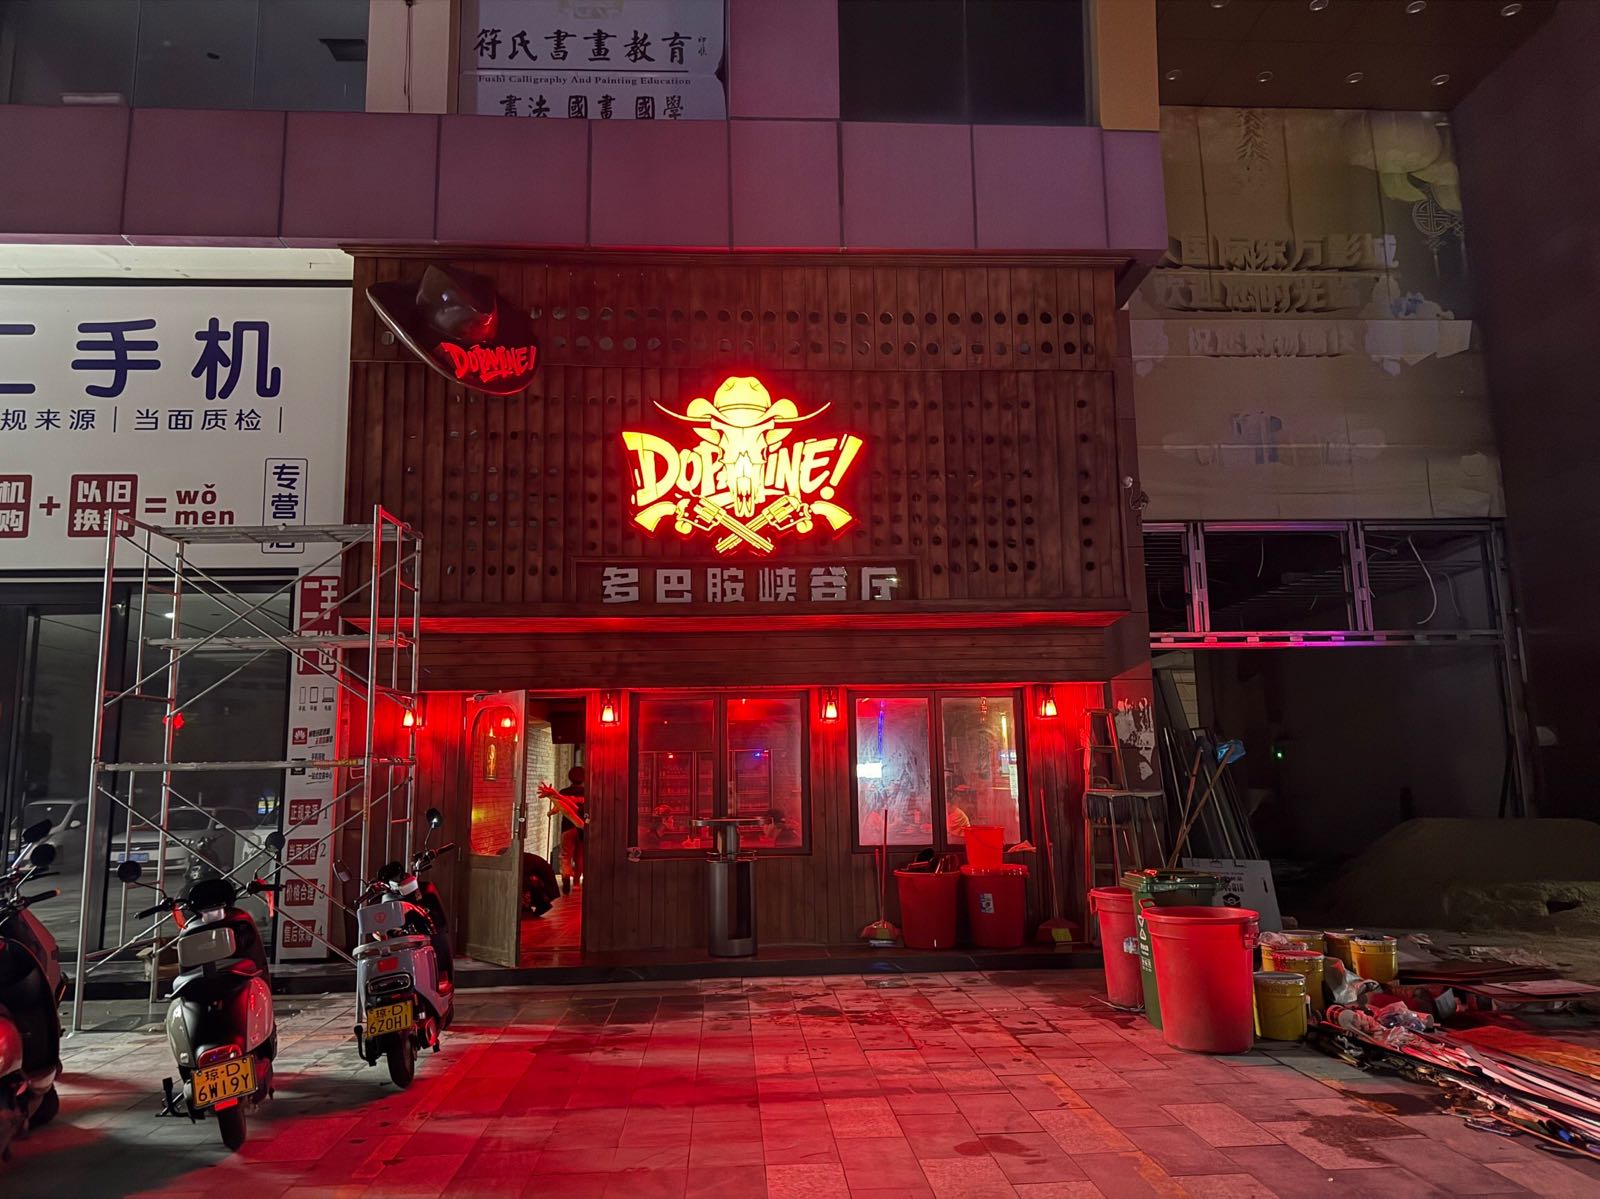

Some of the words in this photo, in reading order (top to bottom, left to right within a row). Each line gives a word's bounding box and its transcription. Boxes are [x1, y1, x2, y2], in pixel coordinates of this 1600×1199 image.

[508, 75, 568, 85] Calligraphy
[571, 76, 592, 84] And
[594, 76, 638, 86] Painting
[640, 77, 691, 85] Education
[0, 408, 97, 431] 规来源
[134, 408, 262, 431] 当面质检
[622, 431, 863, 507] DOPINE!
[77, 481, 132, 503] 以旧
[175, 509, 234, 525] men
[602, 566, 898, 603] 多巴胺峡谷厅
[198, 1073, 251, 1102] 6W19Y
